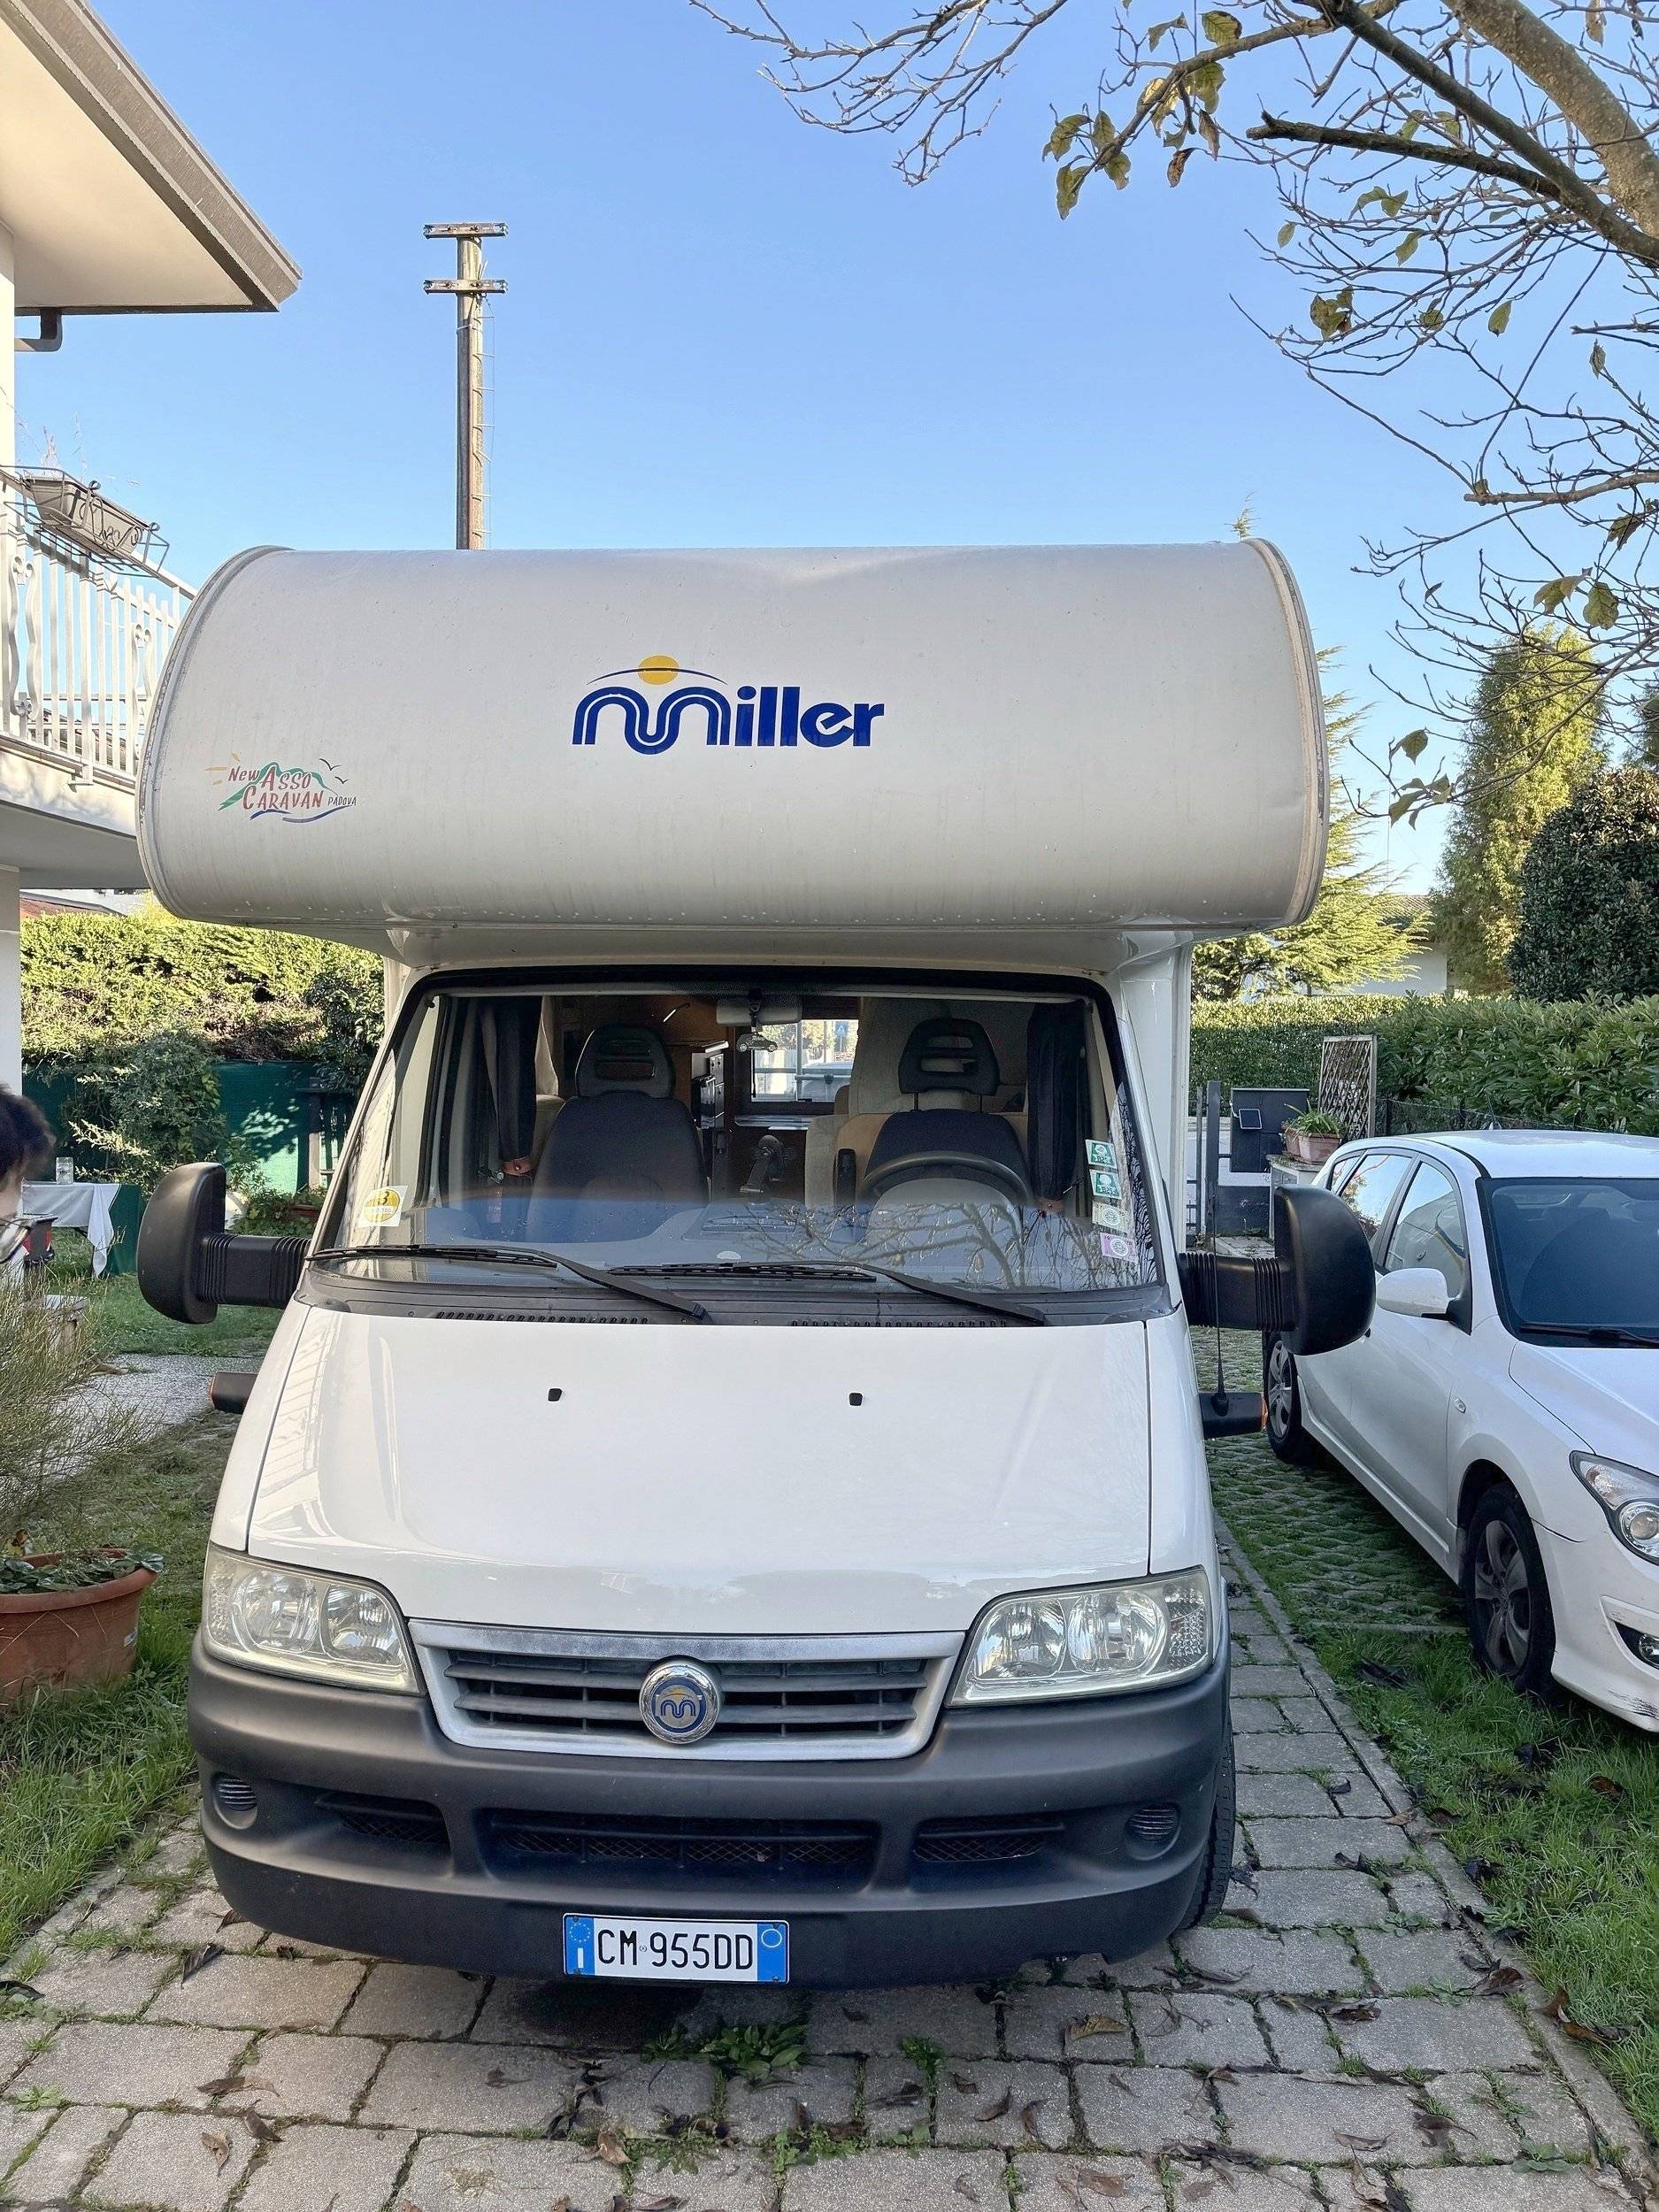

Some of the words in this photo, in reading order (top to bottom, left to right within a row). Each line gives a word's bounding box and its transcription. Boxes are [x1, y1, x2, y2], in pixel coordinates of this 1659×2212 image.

[228, 766, 259, 781] New
[242, 786, 324, 810] CARAVAN
[327, 796, 357, 806] PADOVA
